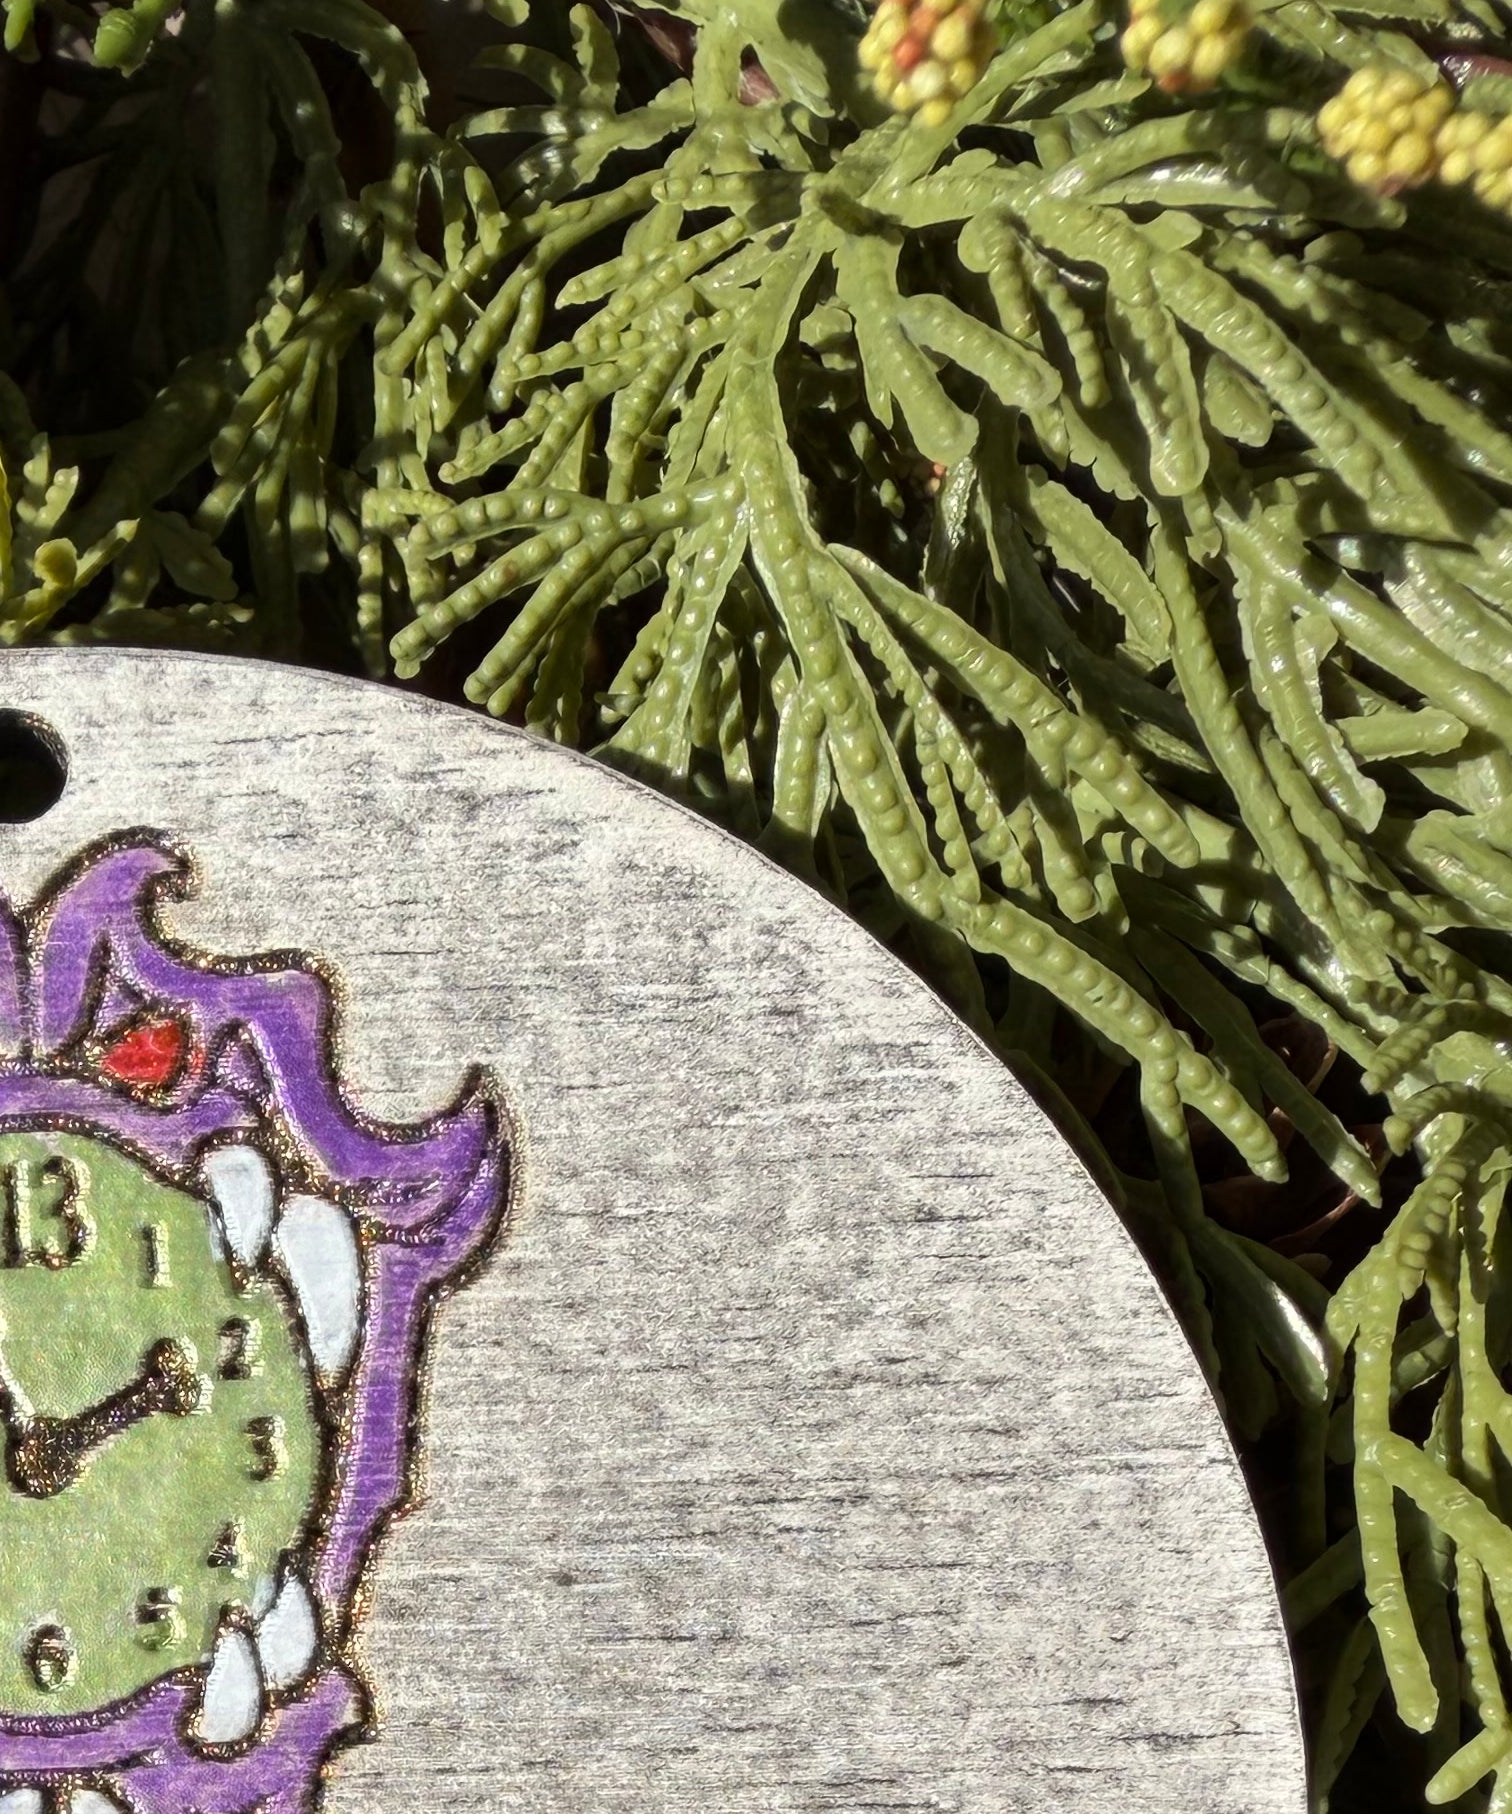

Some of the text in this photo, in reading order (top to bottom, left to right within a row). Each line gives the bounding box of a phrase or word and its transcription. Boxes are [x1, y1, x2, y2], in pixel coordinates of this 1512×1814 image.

[0, 1156, 97, 1269] 13
[142, 1220, 171, 1288] 1
[218, 1315, 265, 1381] 2
[244, 1414, 288, 1481] 3
[206, 1514, 254, 1579] 4
[137, 1585, 187, 1651] 5
[22, 1623, 79, 1692] 6
